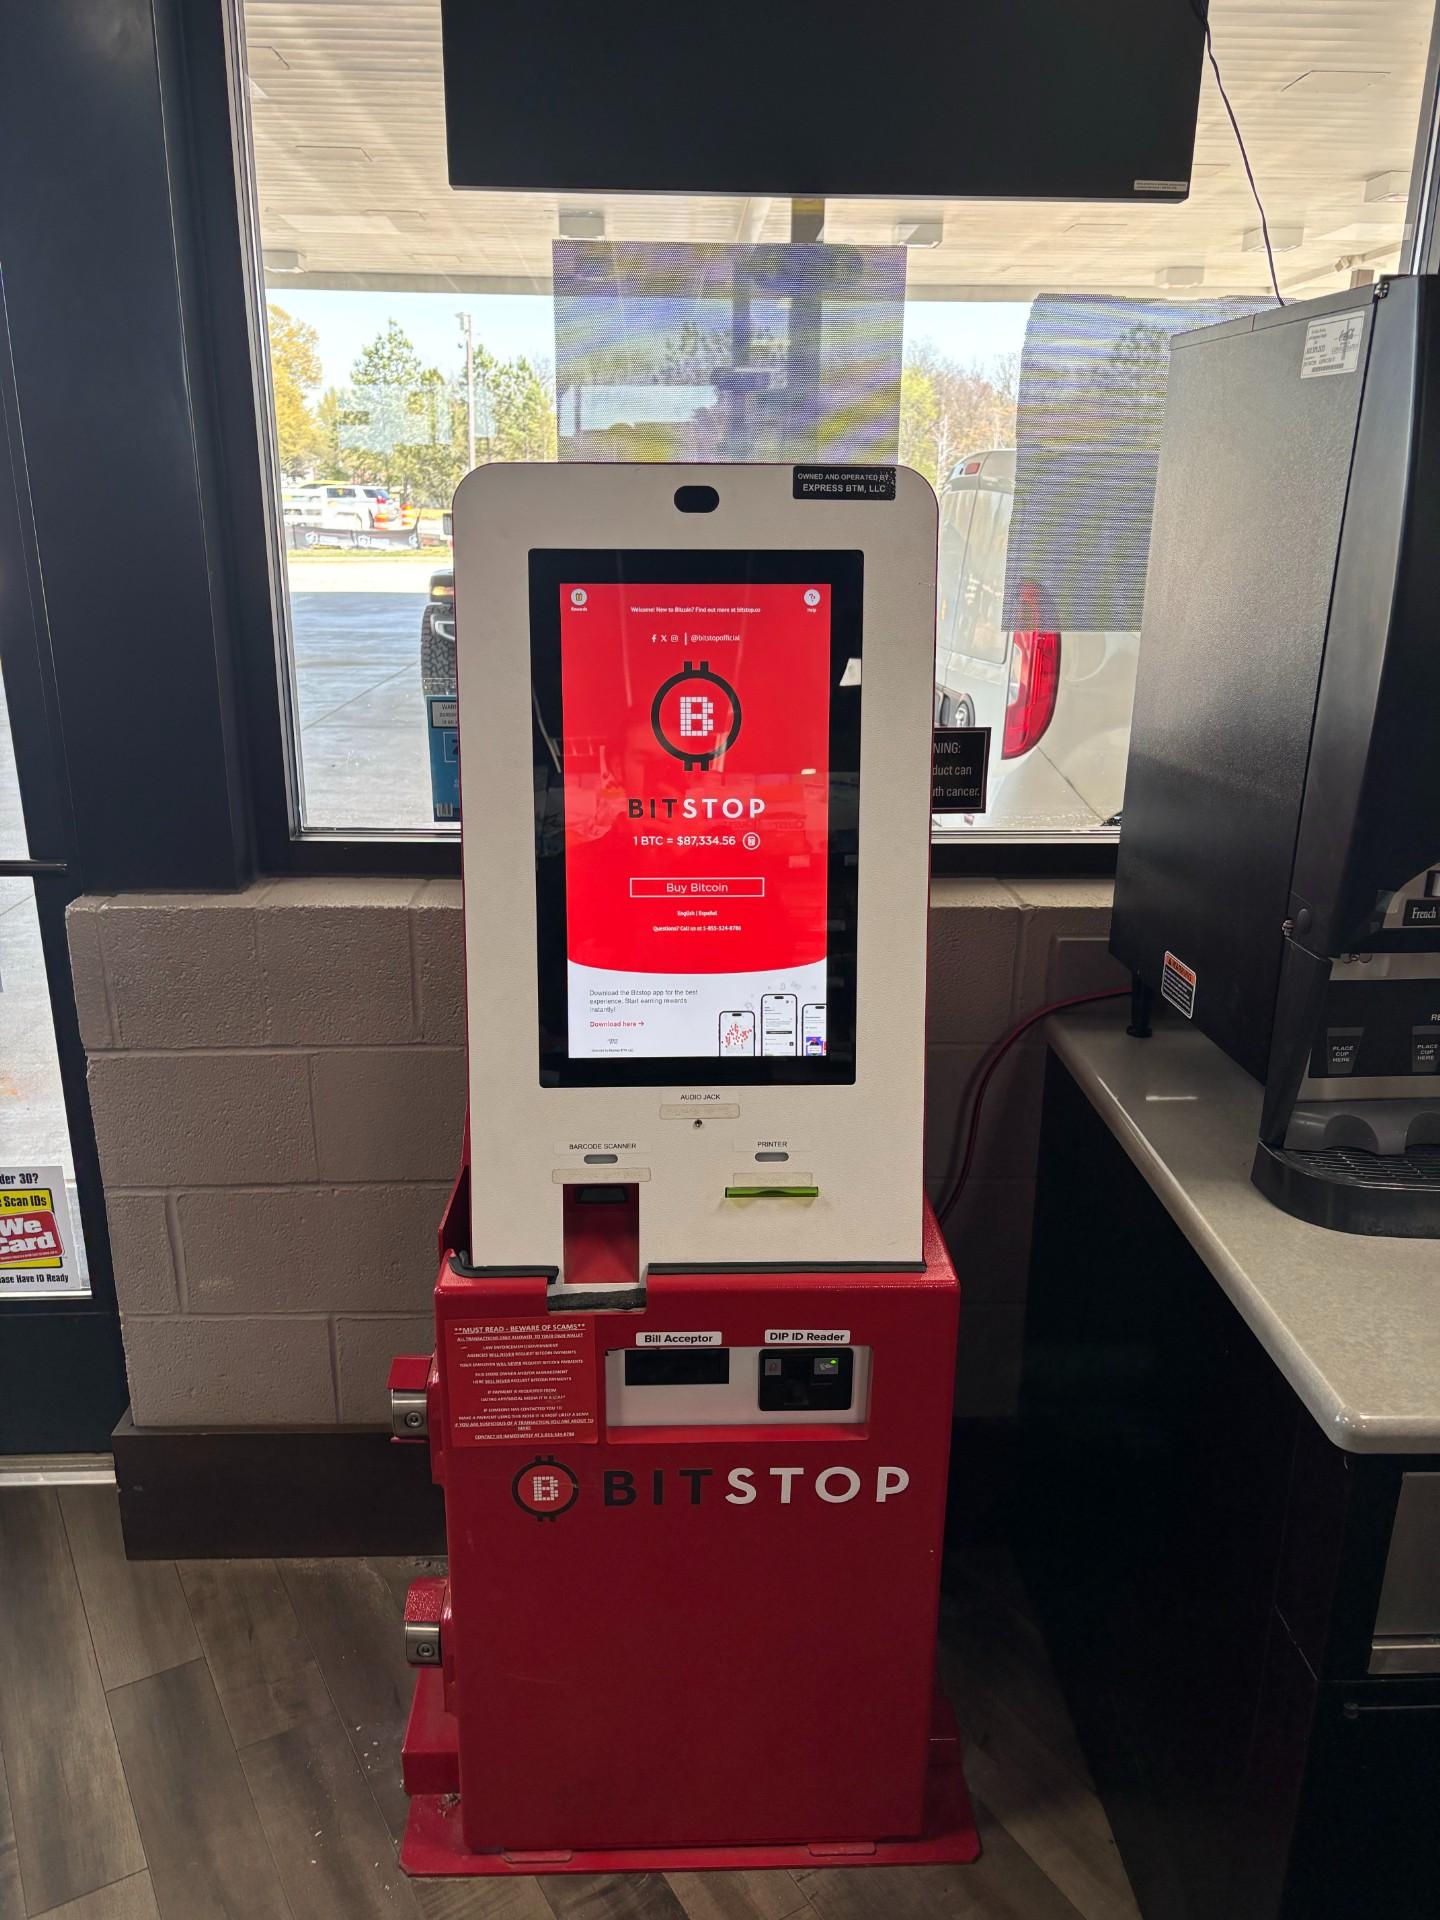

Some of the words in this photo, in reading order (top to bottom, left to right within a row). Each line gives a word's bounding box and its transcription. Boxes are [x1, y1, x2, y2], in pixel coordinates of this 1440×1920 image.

[802, 484, 843, 492] EXPRESS
[846, 485, 866, 493] BTM,
[690, 634, 740, 642] @bitstopofficial
[933, 742, 960, 754] NING:
[932, 764, 952, 776] duct
[955, 766, 972, 776] can
[946, 787, 980, 797] cancer.
[628, 798, 766, 818] BITSTOP
[633, 836, 638, 846] 1
[641, 836, 664, 846] BTC
[677, 836, 736, 846] $87,334.56
[666, 883, 687, 894] Buy
[691, 883, 728, 892] Bitcoin
[1412, 907, 1436, 920] French
[604, 1142, 636, 1150] SCANNER
[0, 1174, 16, 1184] der
[19, 1173, 38, 1184] 30?
[4, 1196, 28, 1207] Scan
[31, 1196, 47, 1206] IDs
[0, 1218, 42, 1236] We
[16, 1274, 35, 1282] Have
[36, 1274, 44, 1282] ID
[46, 1274, 68, 1284] Ready
[644, 1334, 662, 1344] Bill
[664, 1334, 713, 1344] Acceptor
[770, 1332, 789, 1342] DIP
[792, 1332, 804, 1342] ID
[806, 1332, 844, 1342] Reader
[604, 1466, 910, 1506] BITSTOP
